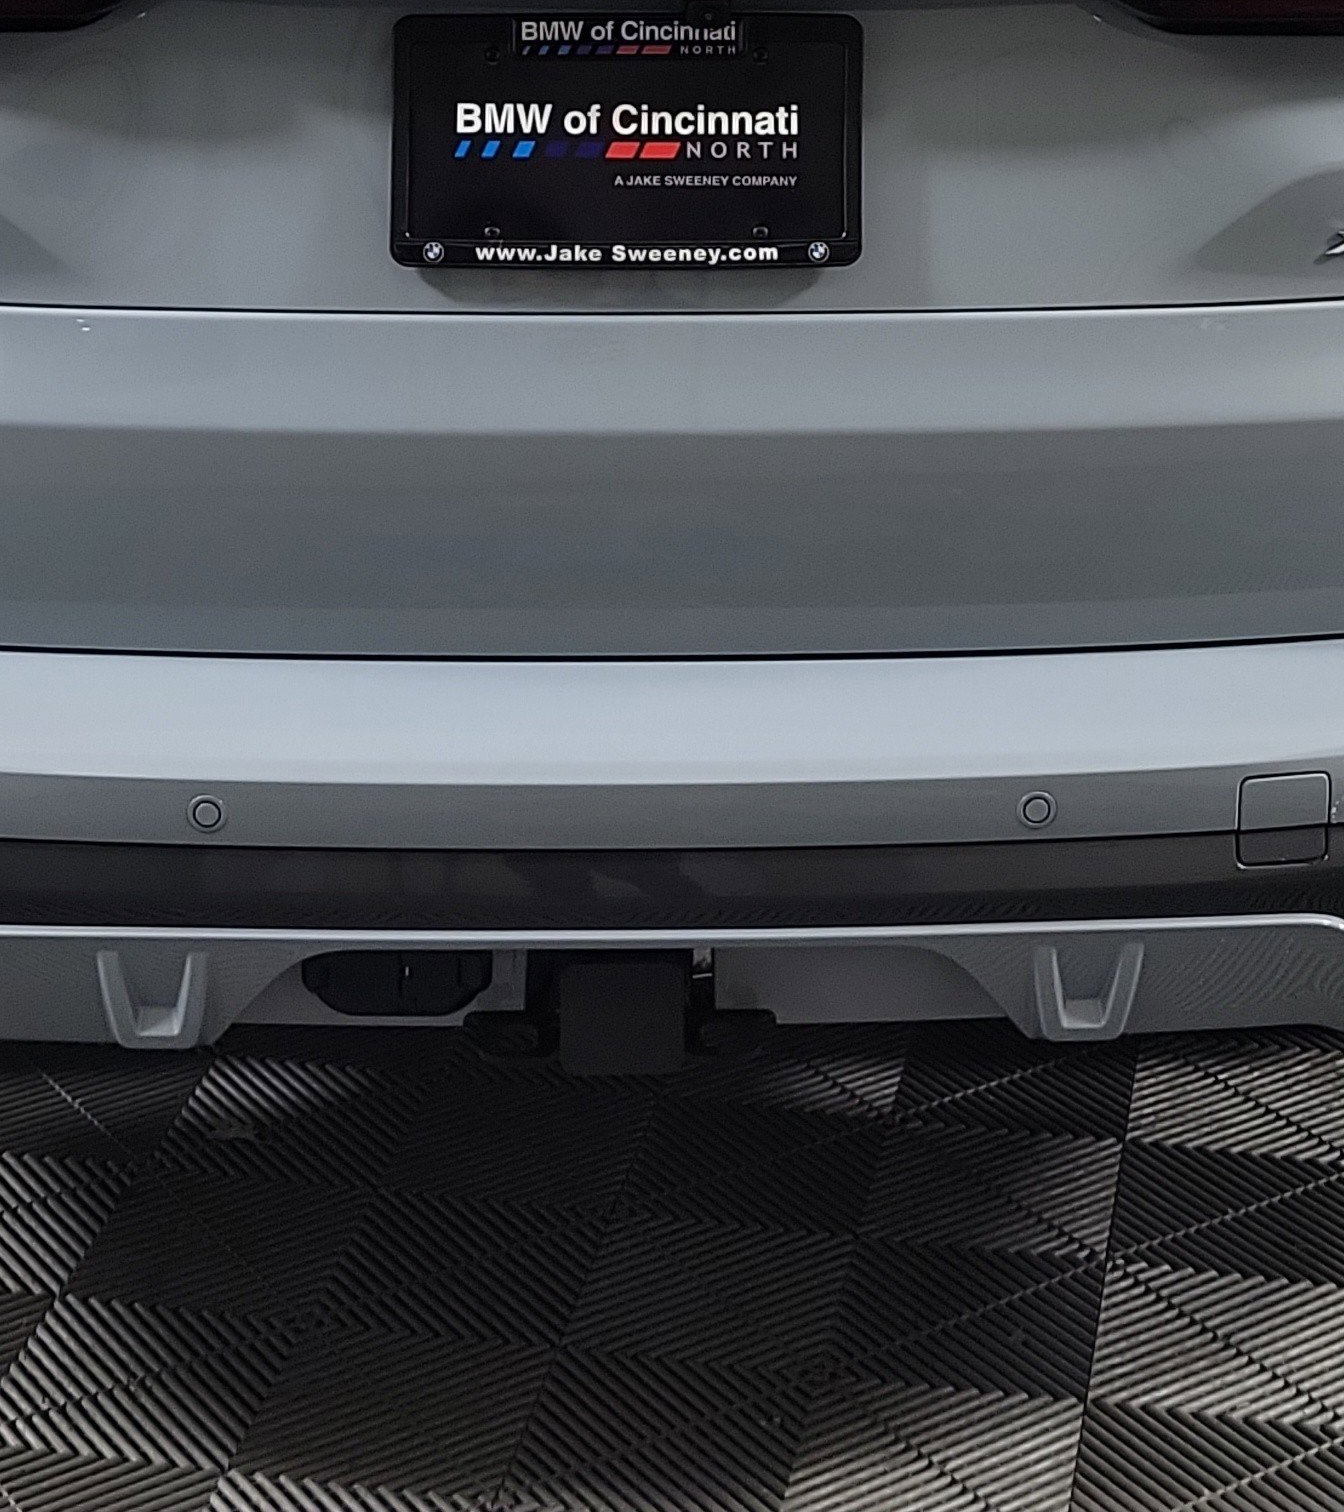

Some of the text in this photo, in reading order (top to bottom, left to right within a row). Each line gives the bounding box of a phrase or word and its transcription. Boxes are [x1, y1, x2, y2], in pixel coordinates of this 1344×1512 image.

[521, 21, 584, 41] BMW
[590, 21, 614, 41] of
[680, 45, 736, 55] NORTH
[456, 103, 799, 136] BMW of Cincinnati
[686, 142, 798, 159] NORTH
[614, 175, 798, 186] A JAKE SWEENEY COMPANY
[475, 245, 779, 264] www.Jake Sweeney.com
